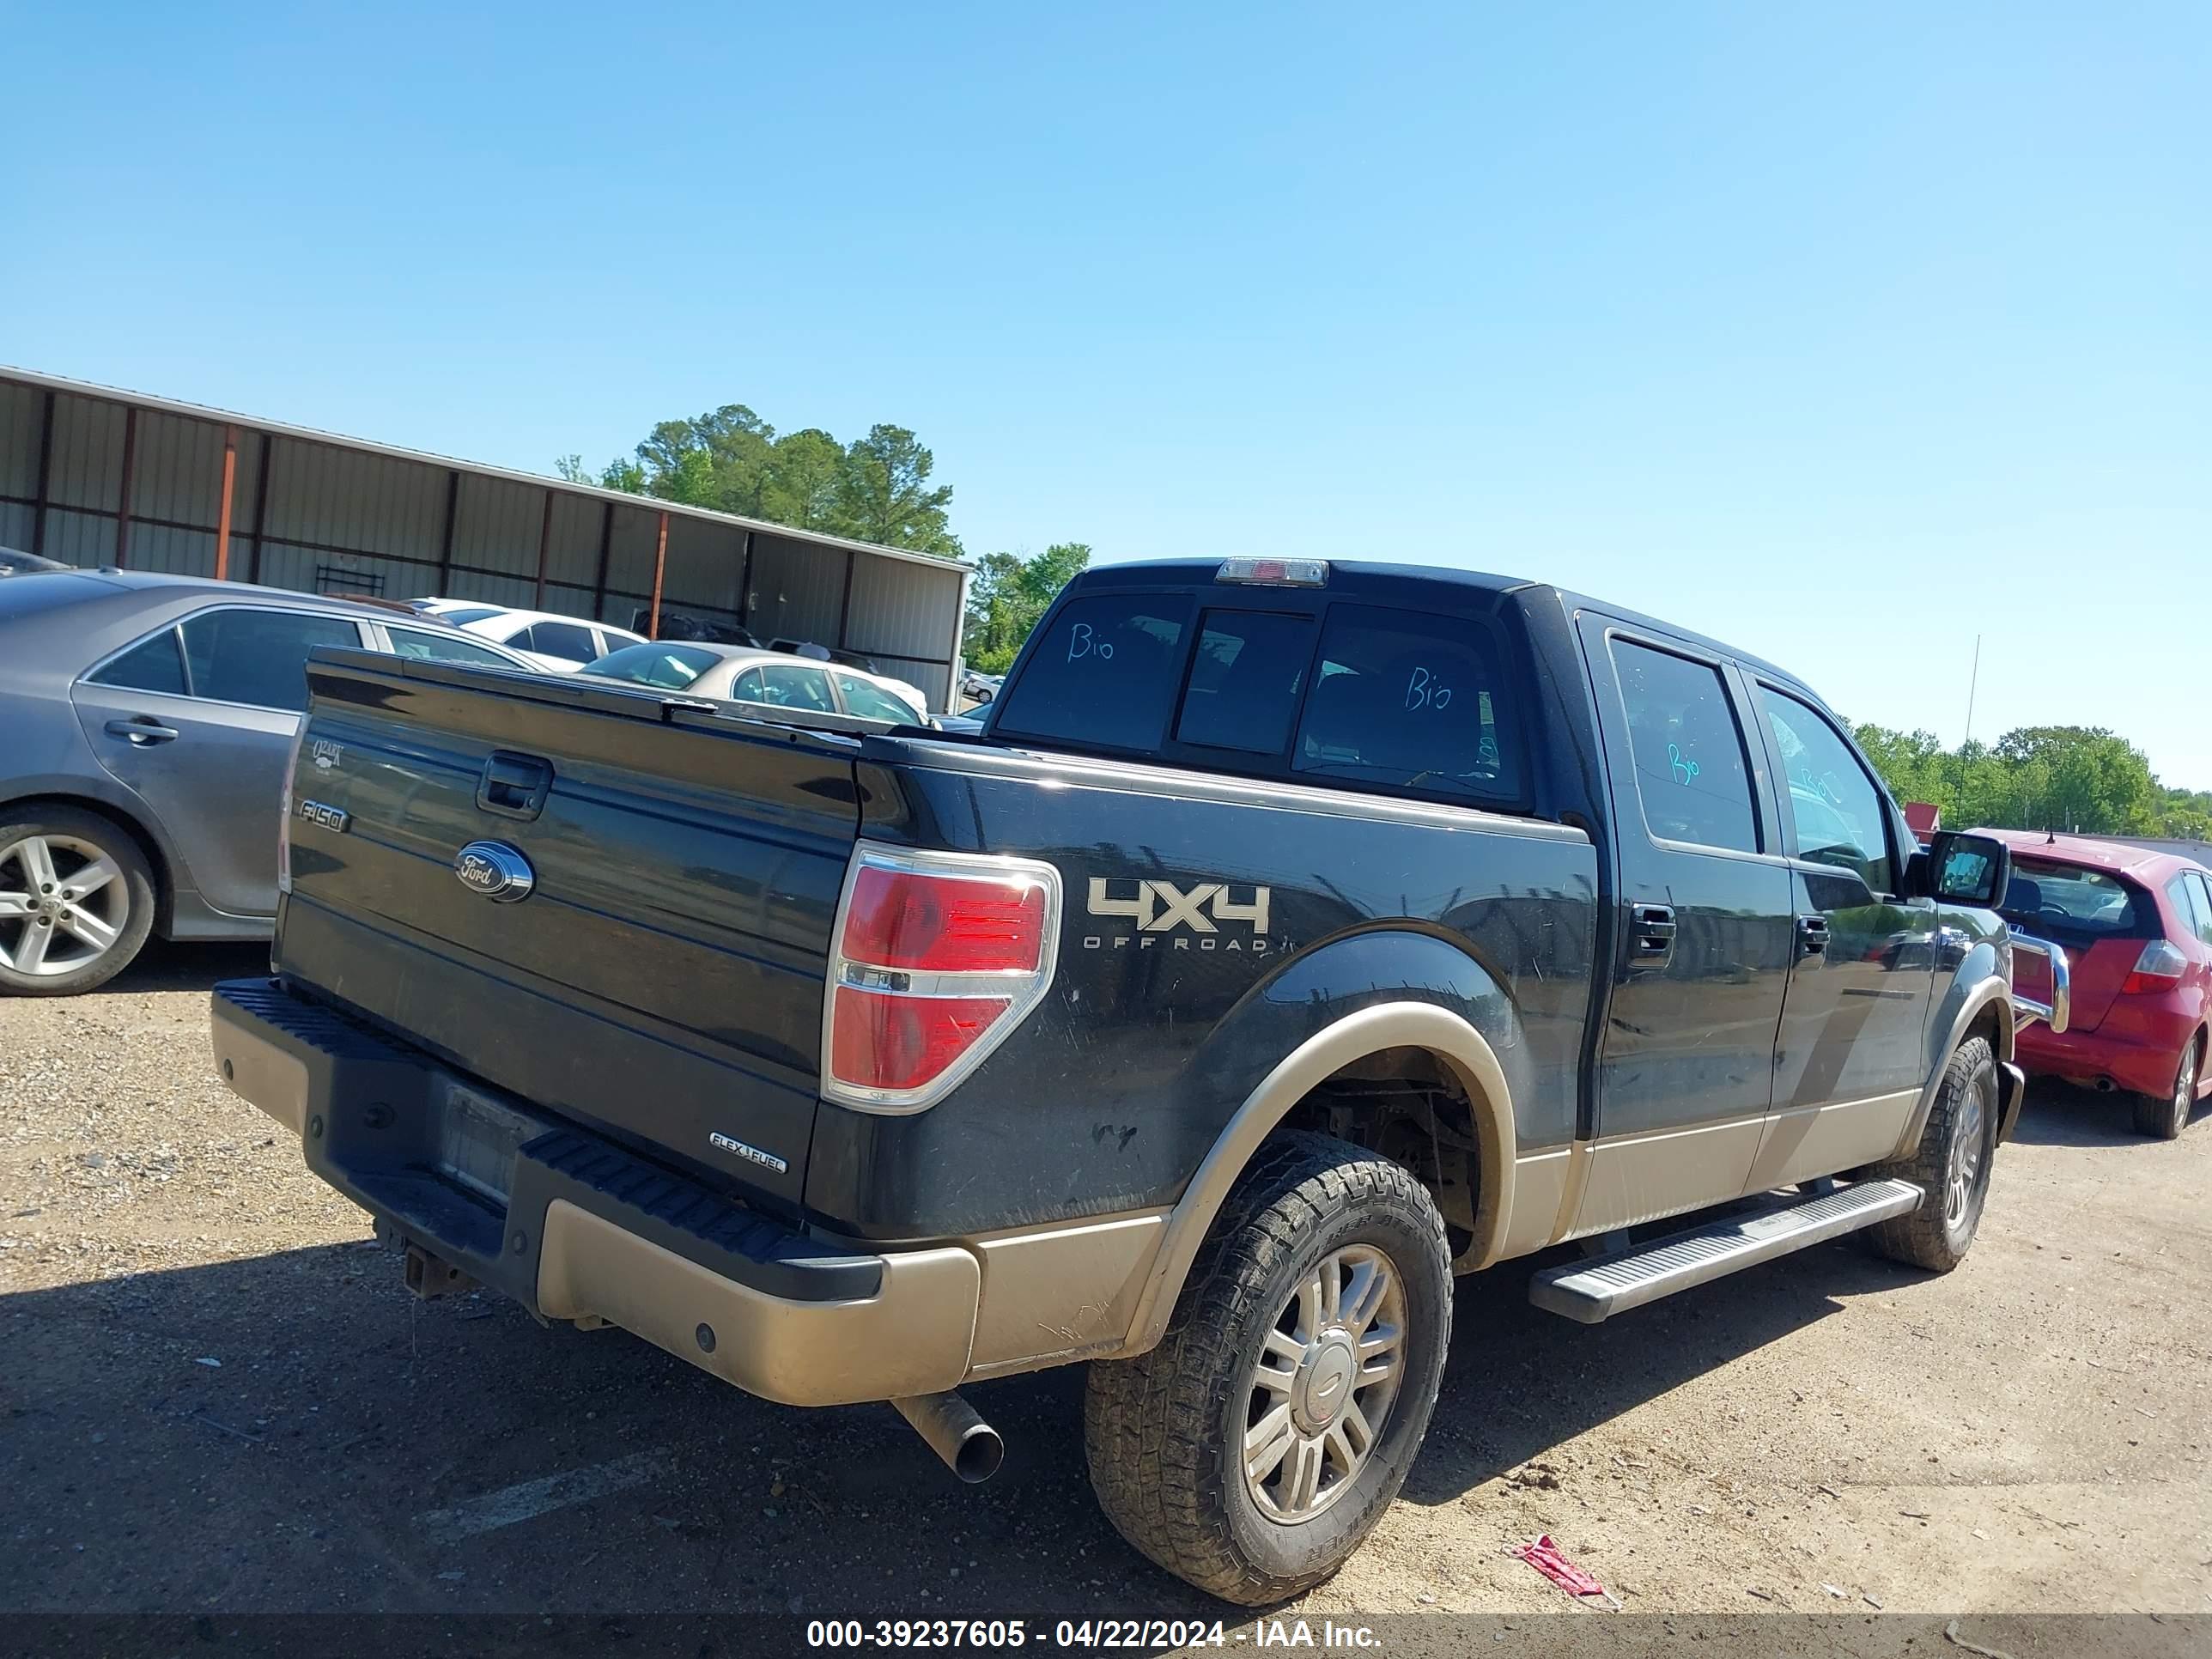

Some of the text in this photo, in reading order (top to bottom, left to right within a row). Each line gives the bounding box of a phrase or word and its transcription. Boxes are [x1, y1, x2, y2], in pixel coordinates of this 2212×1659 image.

[1067, 623, 1114, 663] Bio
[1406, 667, 1451, 711] Bio
[313, 739, 344, 767] OZARK
[460, 855, 493, 885] Ford
[1084, 936, 1267, 951] OFF ROAD
[713, 1134, 782, 1172] FLEX FUEL
